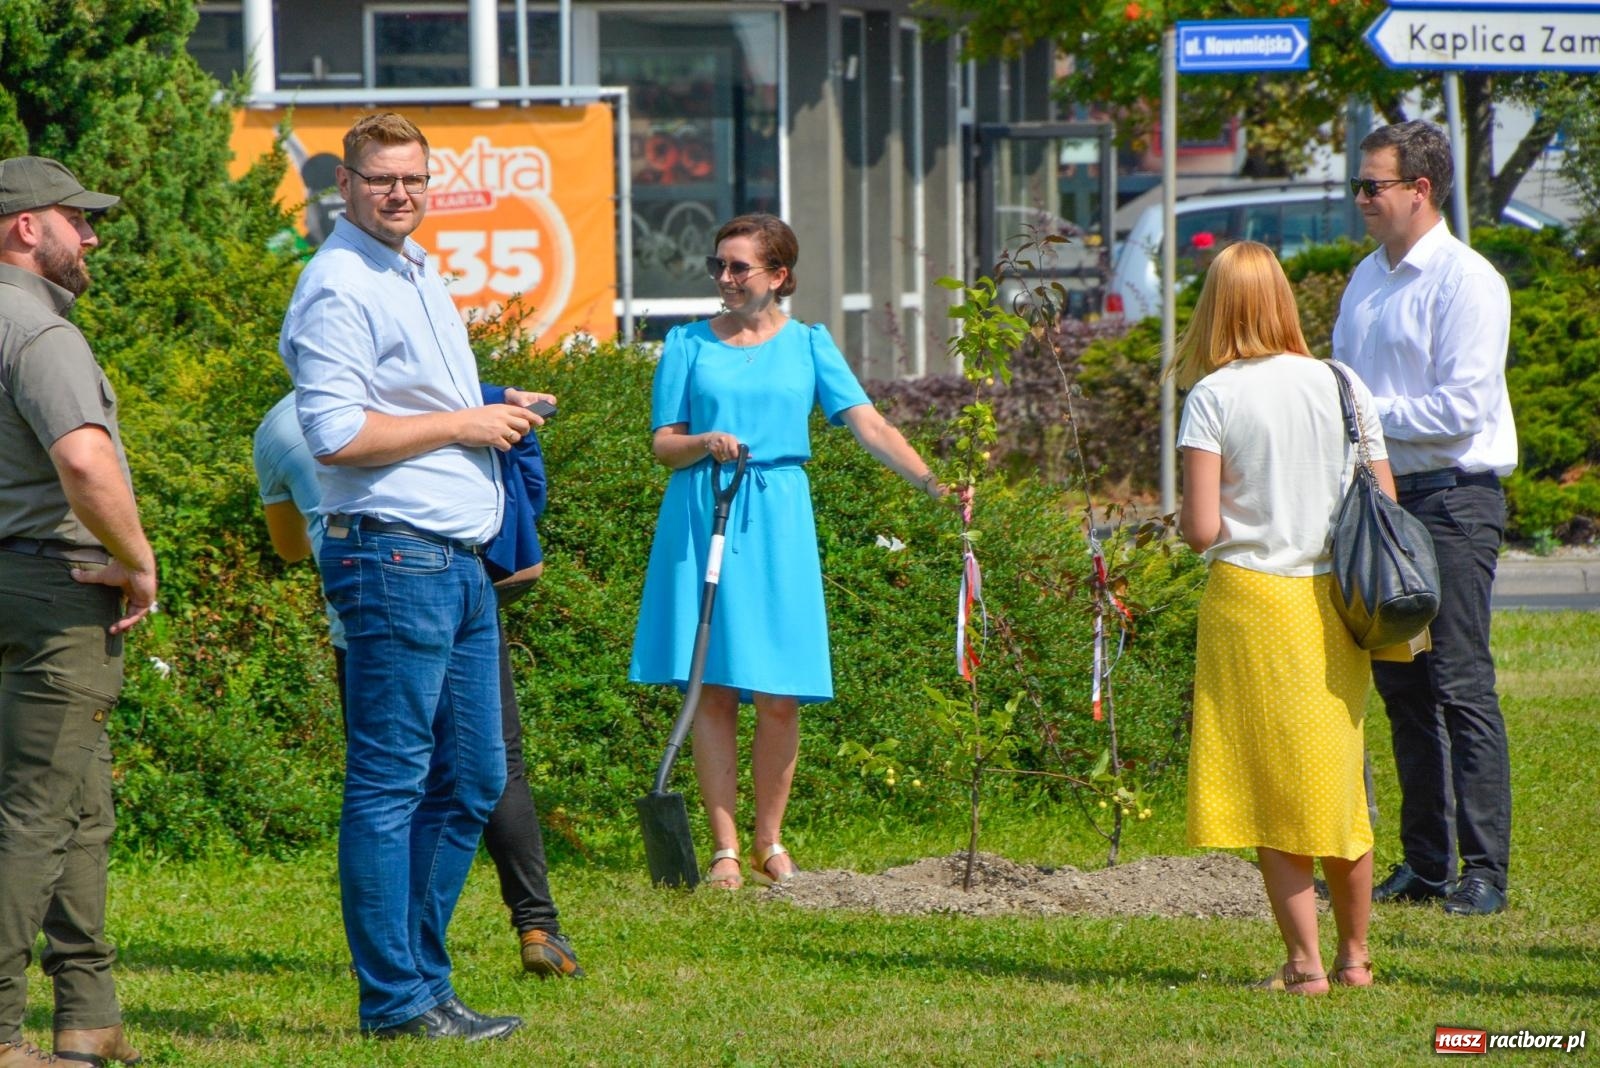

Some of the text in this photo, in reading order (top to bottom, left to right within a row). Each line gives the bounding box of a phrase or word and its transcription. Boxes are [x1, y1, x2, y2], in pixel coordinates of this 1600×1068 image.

[1185, 34, 1292, 56] ul. Nowomiejska
[1409, 24, 1526, 59] Kaplica
[429, 141, 547, 191] extra
